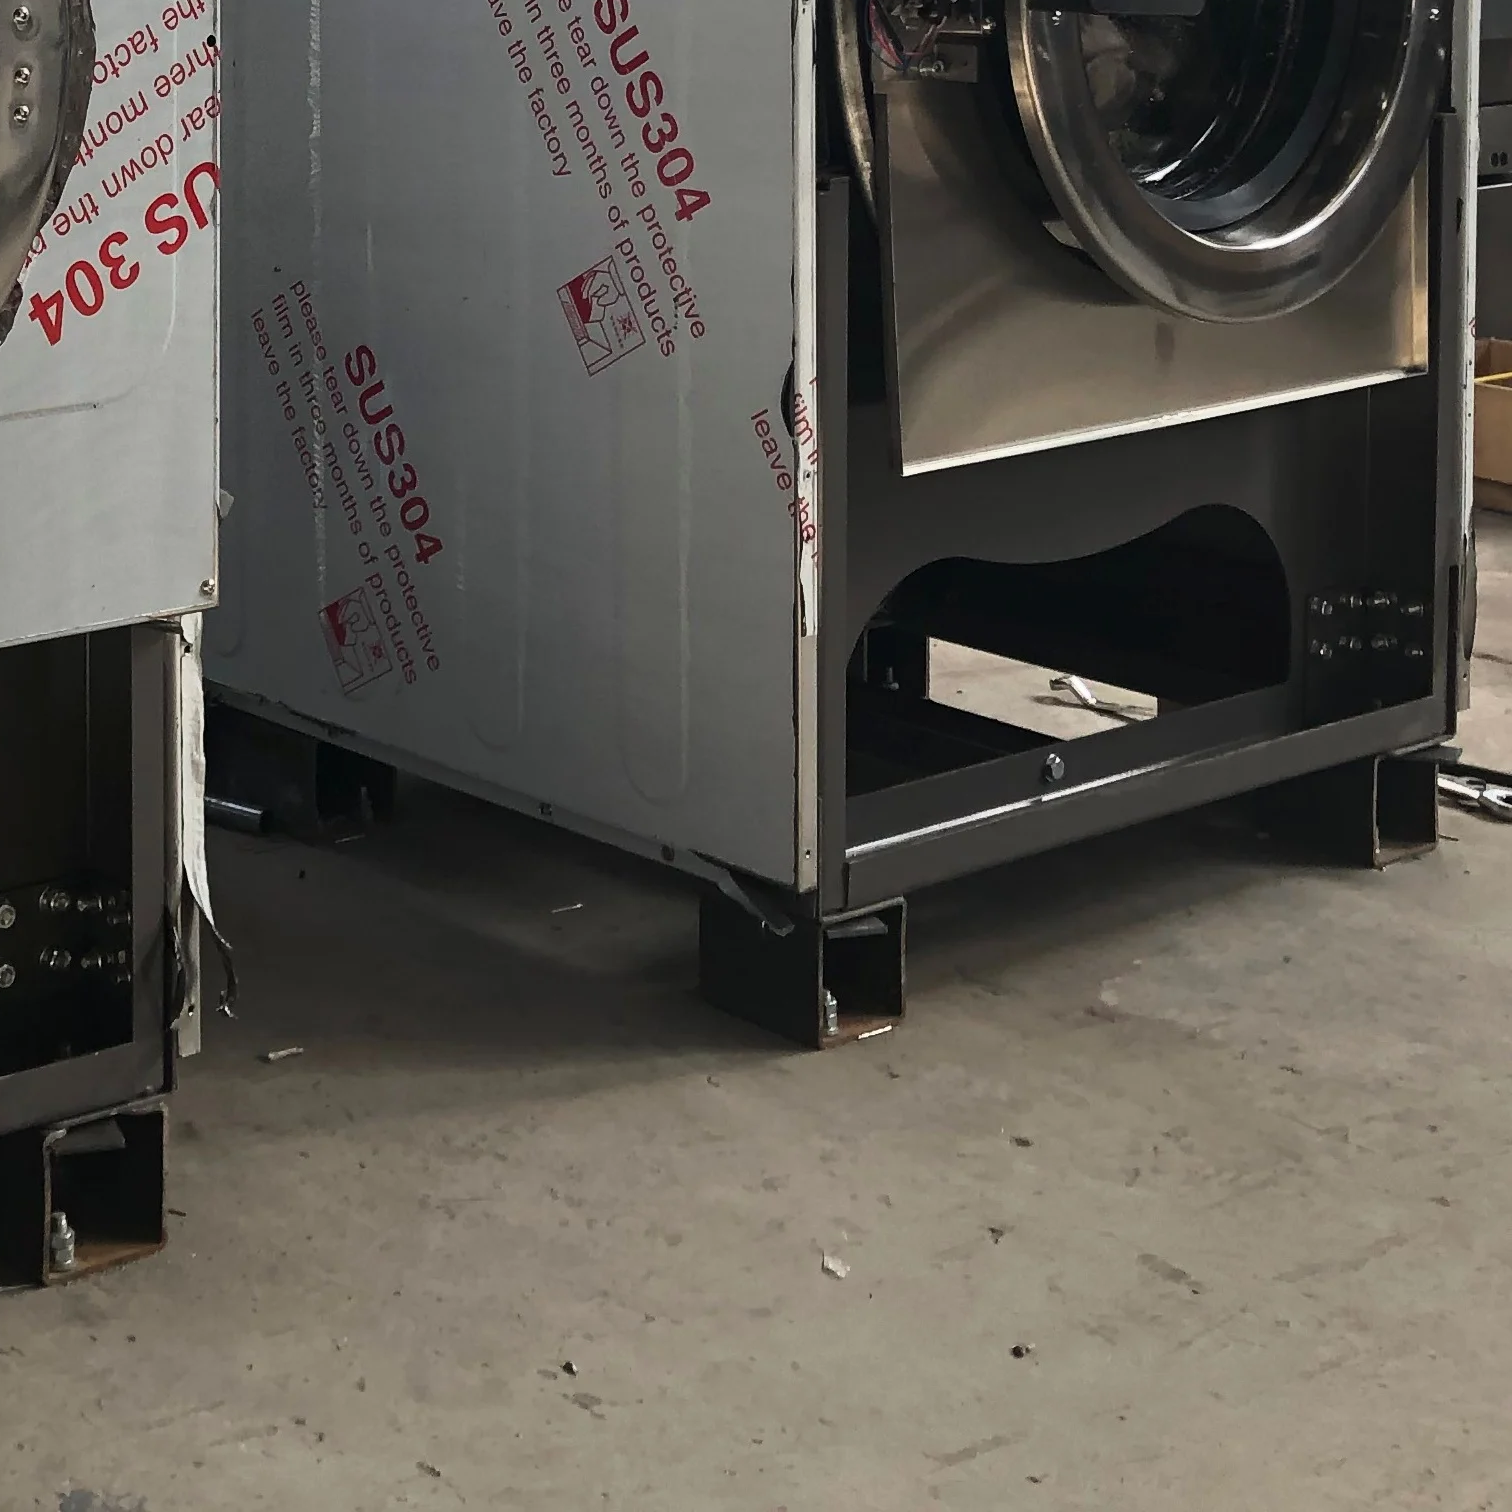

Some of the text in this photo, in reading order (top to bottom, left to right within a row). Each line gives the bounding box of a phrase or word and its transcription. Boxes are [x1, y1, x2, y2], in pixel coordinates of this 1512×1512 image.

[91, 23, 160, 85] facto
[506, 38, 533, 85] the
[526, 87, 572, 179] factory
[536, 24, 571, 96] three
[53, 92, 221, 237] ear down the
[73, 90, 150, 168] mont
[564, 99, 613, 200] months
[566, 15, 598, 69] tear
[589, 75, 626, 150] down
[619, 151, 647, 199] the
[635, 203, 706, 340] protective
[607, 204, 630, 233] of
[28, 231, 141, 347] 304
[614, 236, 676, 358] products
[250, 308, 328, 510] leave the factory
[344, 343, 444, 565] SUS304
[750, 407, 793, 492] leave
[271, 292, 417, 686] film in three months of products
[289, 279, 442, 673] please tear down the protective
